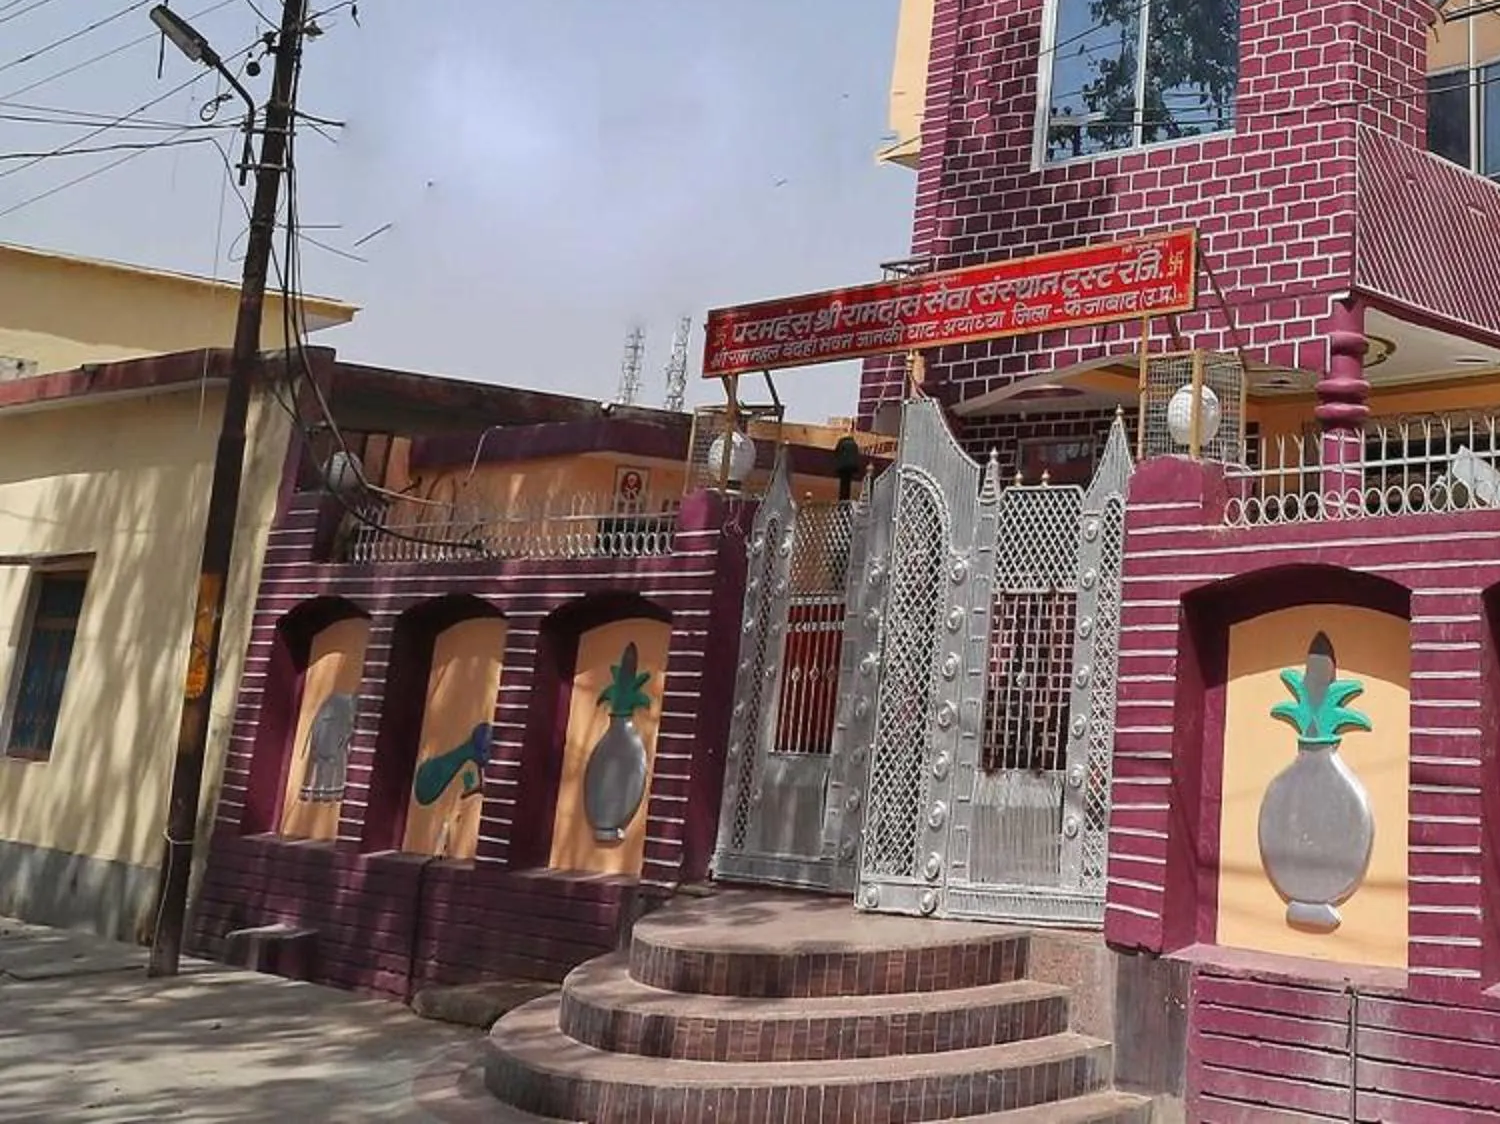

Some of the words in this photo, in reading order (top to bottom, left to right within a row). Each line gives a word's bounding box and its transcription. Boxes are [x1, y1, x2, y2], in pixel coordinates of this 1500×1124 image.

[732, 308, 816, 343] परमहंस
[813, 298, 843, 333] श्री
[924, 284, 976, 315] सेवा
[976, 271, 1062, 305] संस्थान
[1062, 261, 1119, 299] ट्रस्ट
